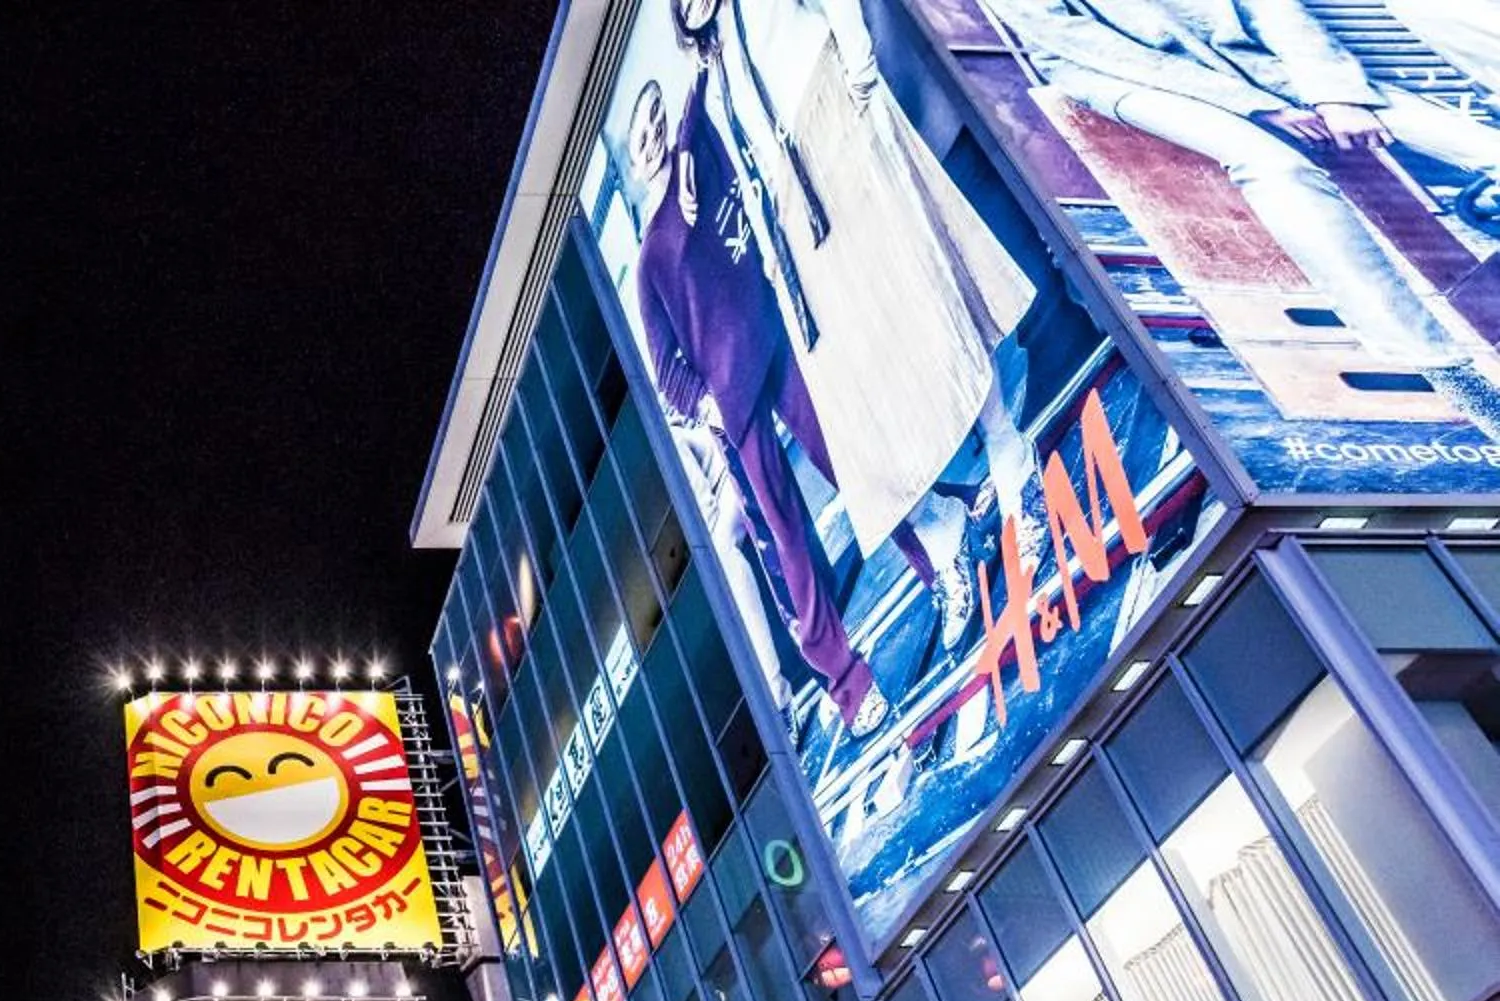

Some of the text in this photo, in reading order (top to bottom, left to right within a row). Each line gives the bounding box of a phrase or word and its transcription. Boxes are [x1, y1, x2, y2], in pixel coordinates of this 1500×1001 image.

[976, 387, 1149, 727] H&M
[163, 796, 413, 902] RENTACAR
[144, 877, 421, 942] ニコニコレンタカー
